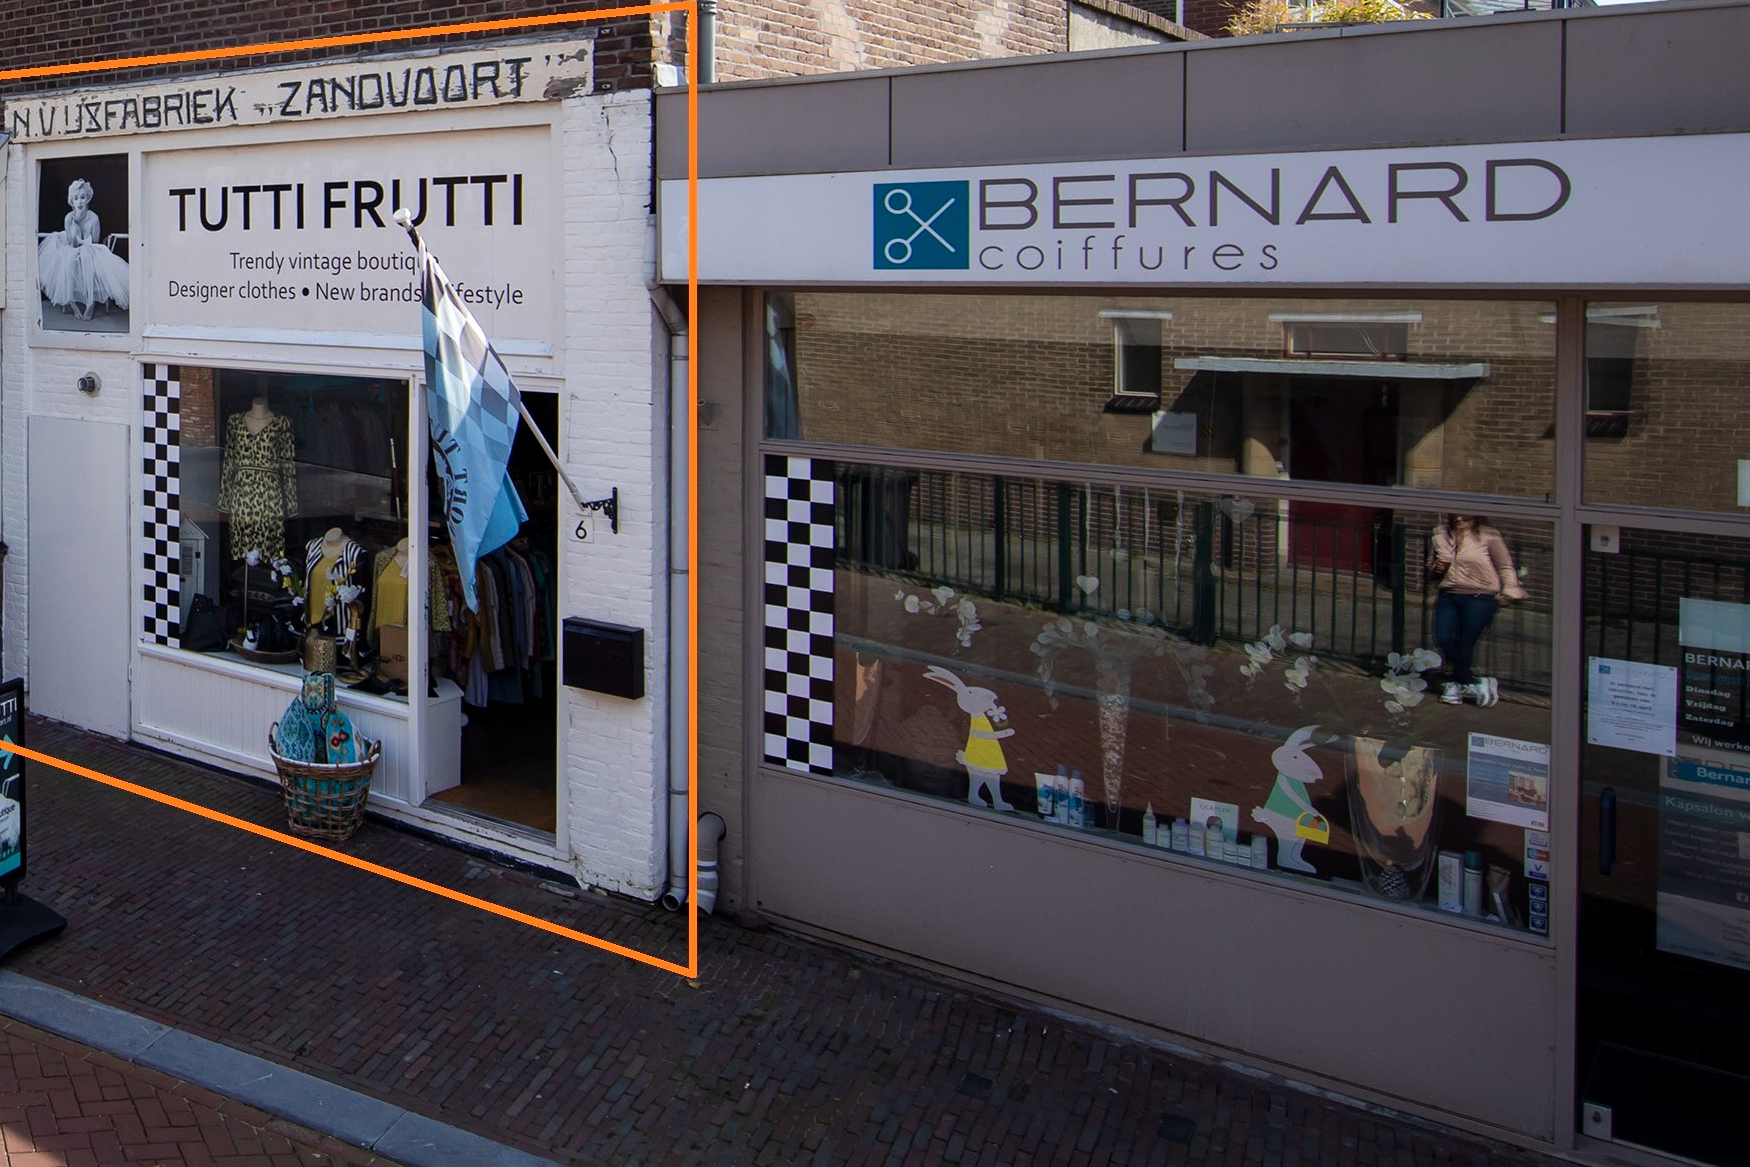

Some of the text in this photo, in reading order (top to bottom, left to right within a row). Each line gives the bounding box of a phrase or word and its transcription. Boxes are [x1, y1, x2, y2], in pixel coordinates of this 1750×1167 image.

[168, 173, 523, 232] TUTTI FRUTTI
[979, 158, 1572, 231] BERNARD
[229, 251, 440, 276] Trendy vintage boutiq
[979, 235, 1279, 272] coiffures
[168, 279, 524, 311] Designer clothes New brands festyle
[575, 520, 587, 540] 6
[1685, 685, 1732, 699] Dinsdag
[1685, 699, 1727, 712] Vrijdag
[1684, 713, 1735, 728] Zaterdag
[1484, 737, 1548, 755] BERNARD
[1691, 735, 1712, 748] Wij
[1665, 796, 1734, 818] Kapsalon
